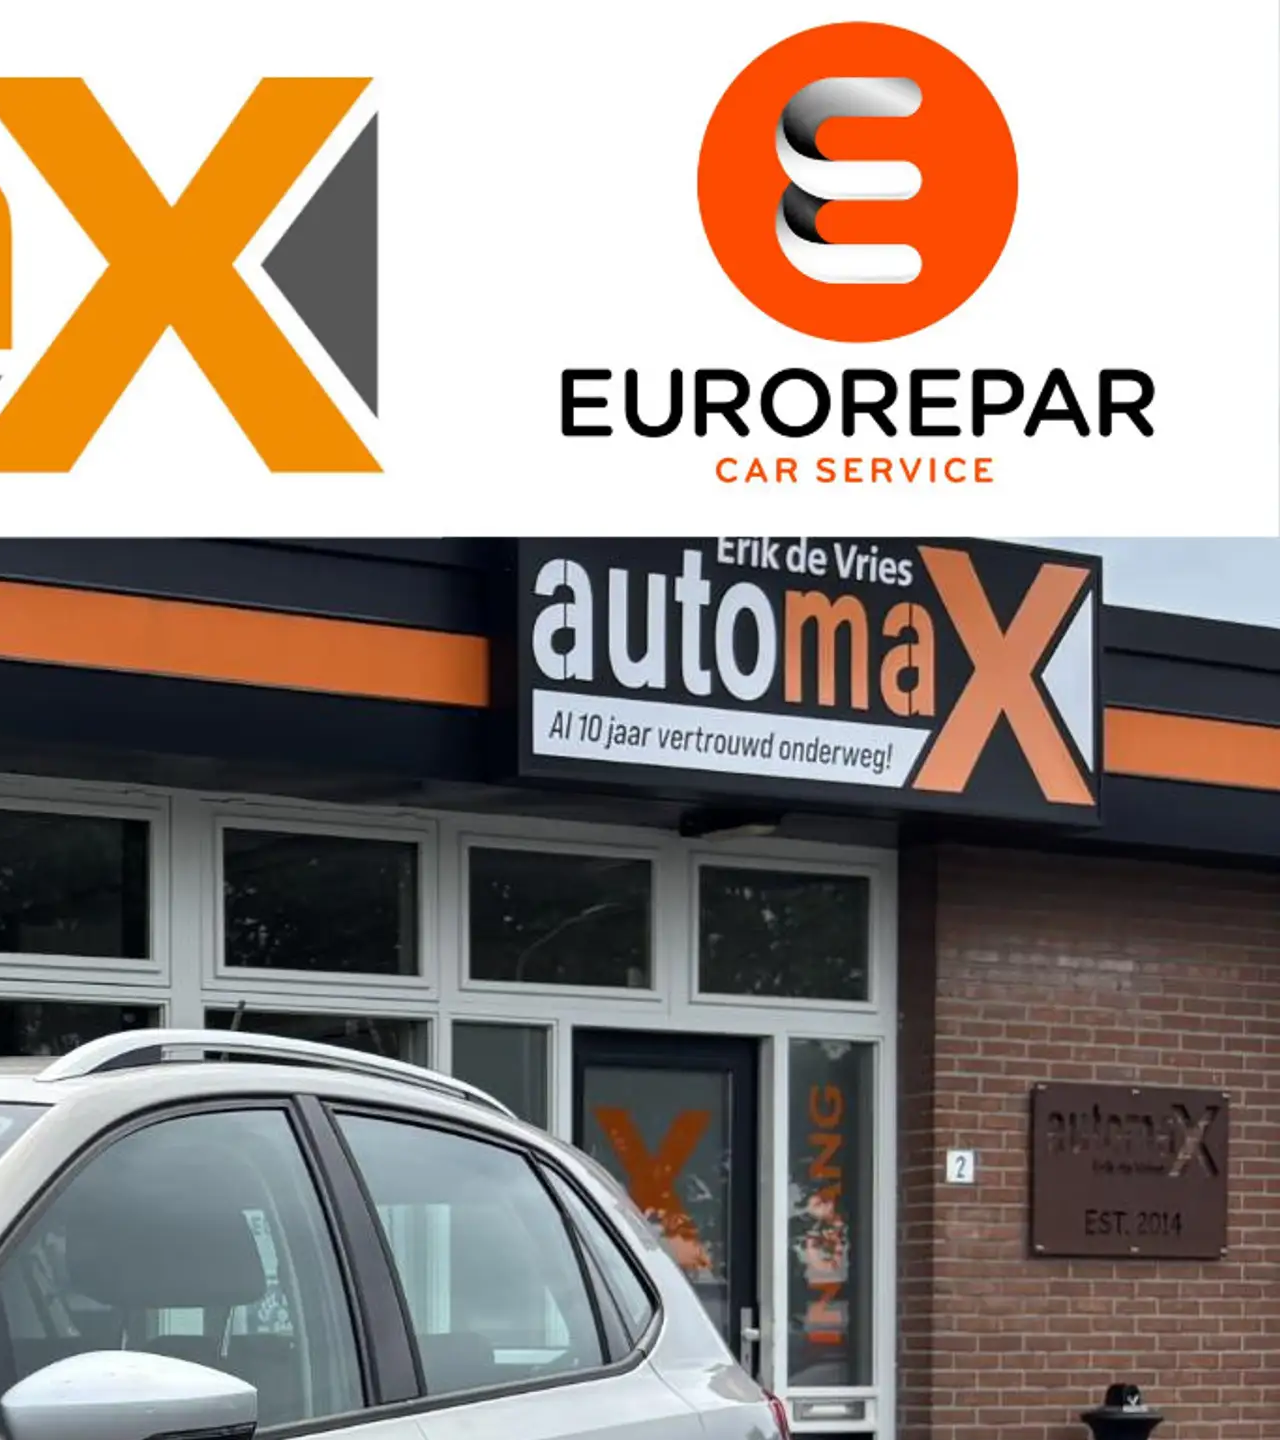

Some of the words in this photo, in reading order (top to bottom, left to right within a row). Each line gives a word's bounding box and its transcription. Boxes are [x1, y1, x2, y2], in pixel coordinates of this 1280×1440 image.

[717, 537, 780, 570] Erik
[786, 537, 828, 575] de
[834, 542, 913, 587] Vries
[531, 546, 1097, 806] automaX
[548, 710, 572, 740] Al
[578, 713, 604, 743] 10
[604, 716, 653, 750] jaar
[657, 727, 775, 760] vertrouwd
[778, 738, 894, 776] onderweg!
[954, 1154, 967, 1179] 2
[1084, 1208, 1130, 1237] EST.
[1136, 1211, 1183, 1237] 2014
